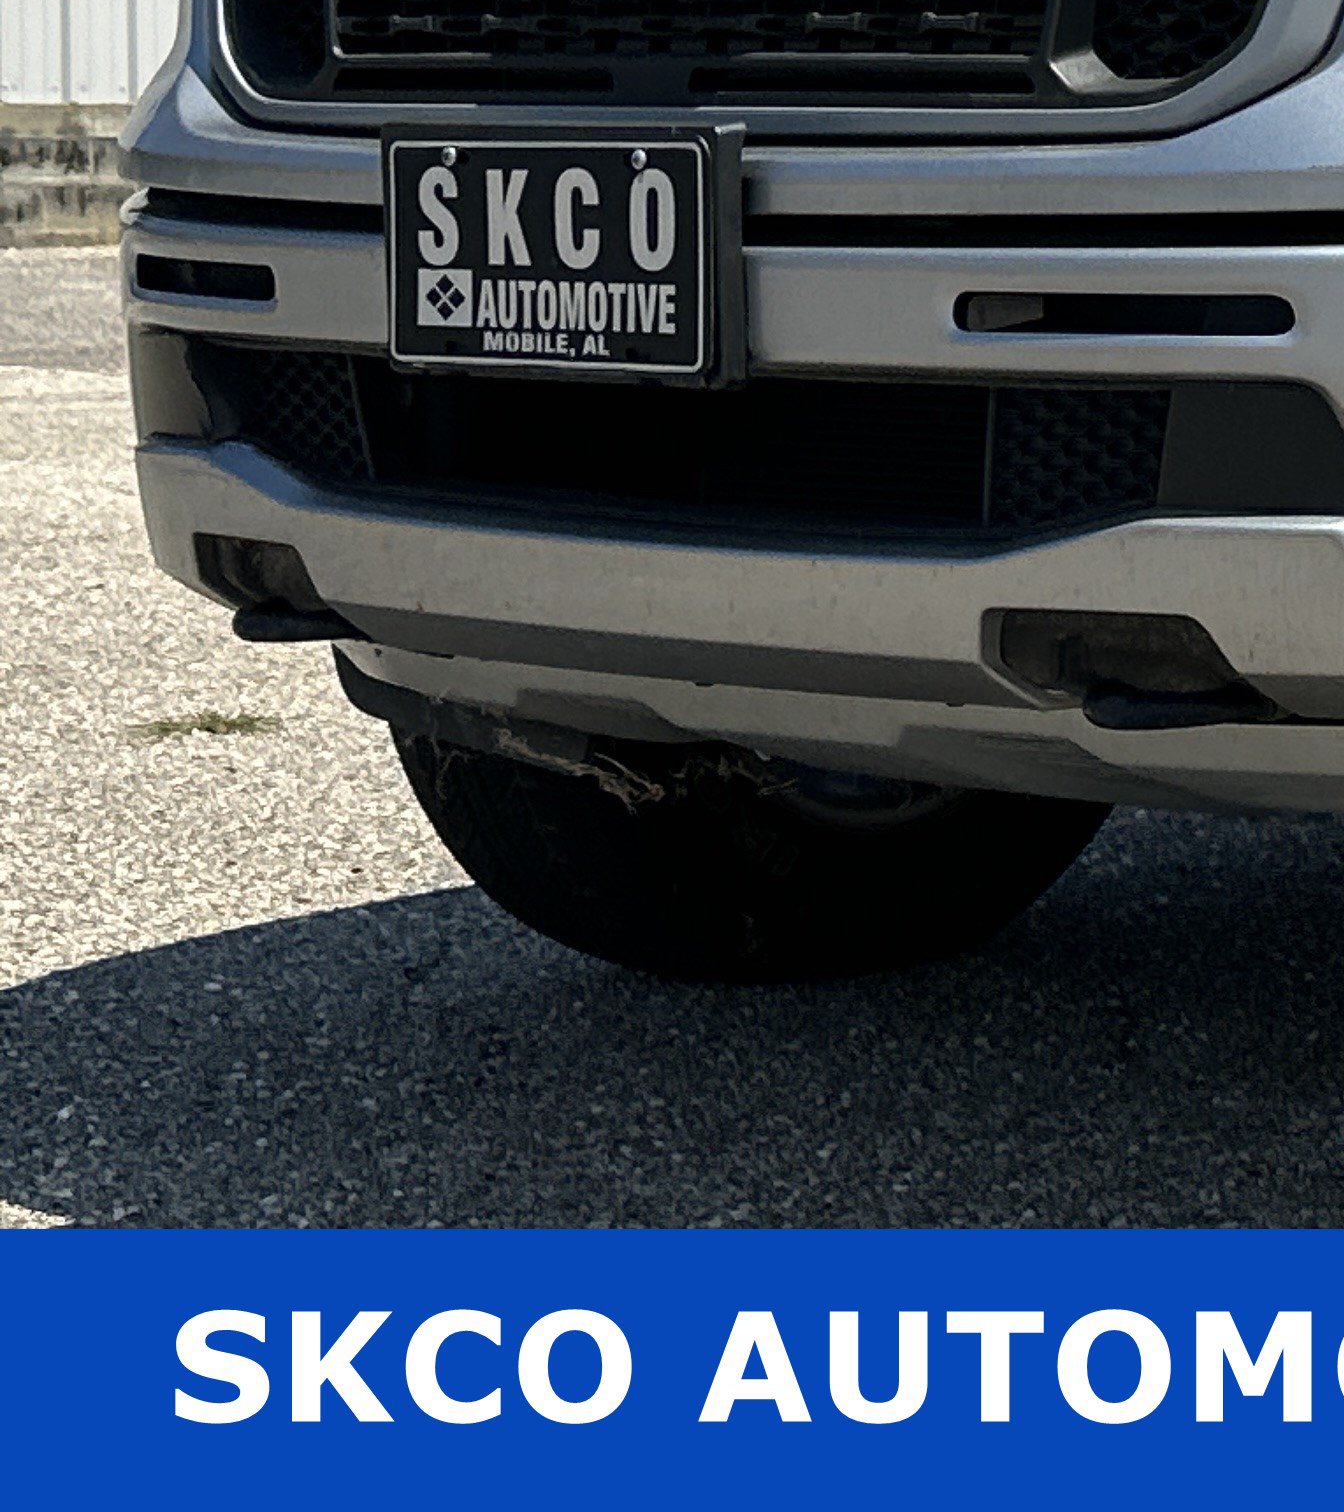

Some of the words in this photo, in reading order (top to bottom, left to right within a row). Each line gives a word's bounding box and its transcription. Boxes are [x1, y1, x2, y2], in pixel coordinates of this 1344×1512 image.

[417, 166, 676, 271] SKCO
[476, 279, 676, 334] AUTOMOTIVE
[483, 331, 576, 357] MOBILE,
[582, 336, 610, 356] AL
